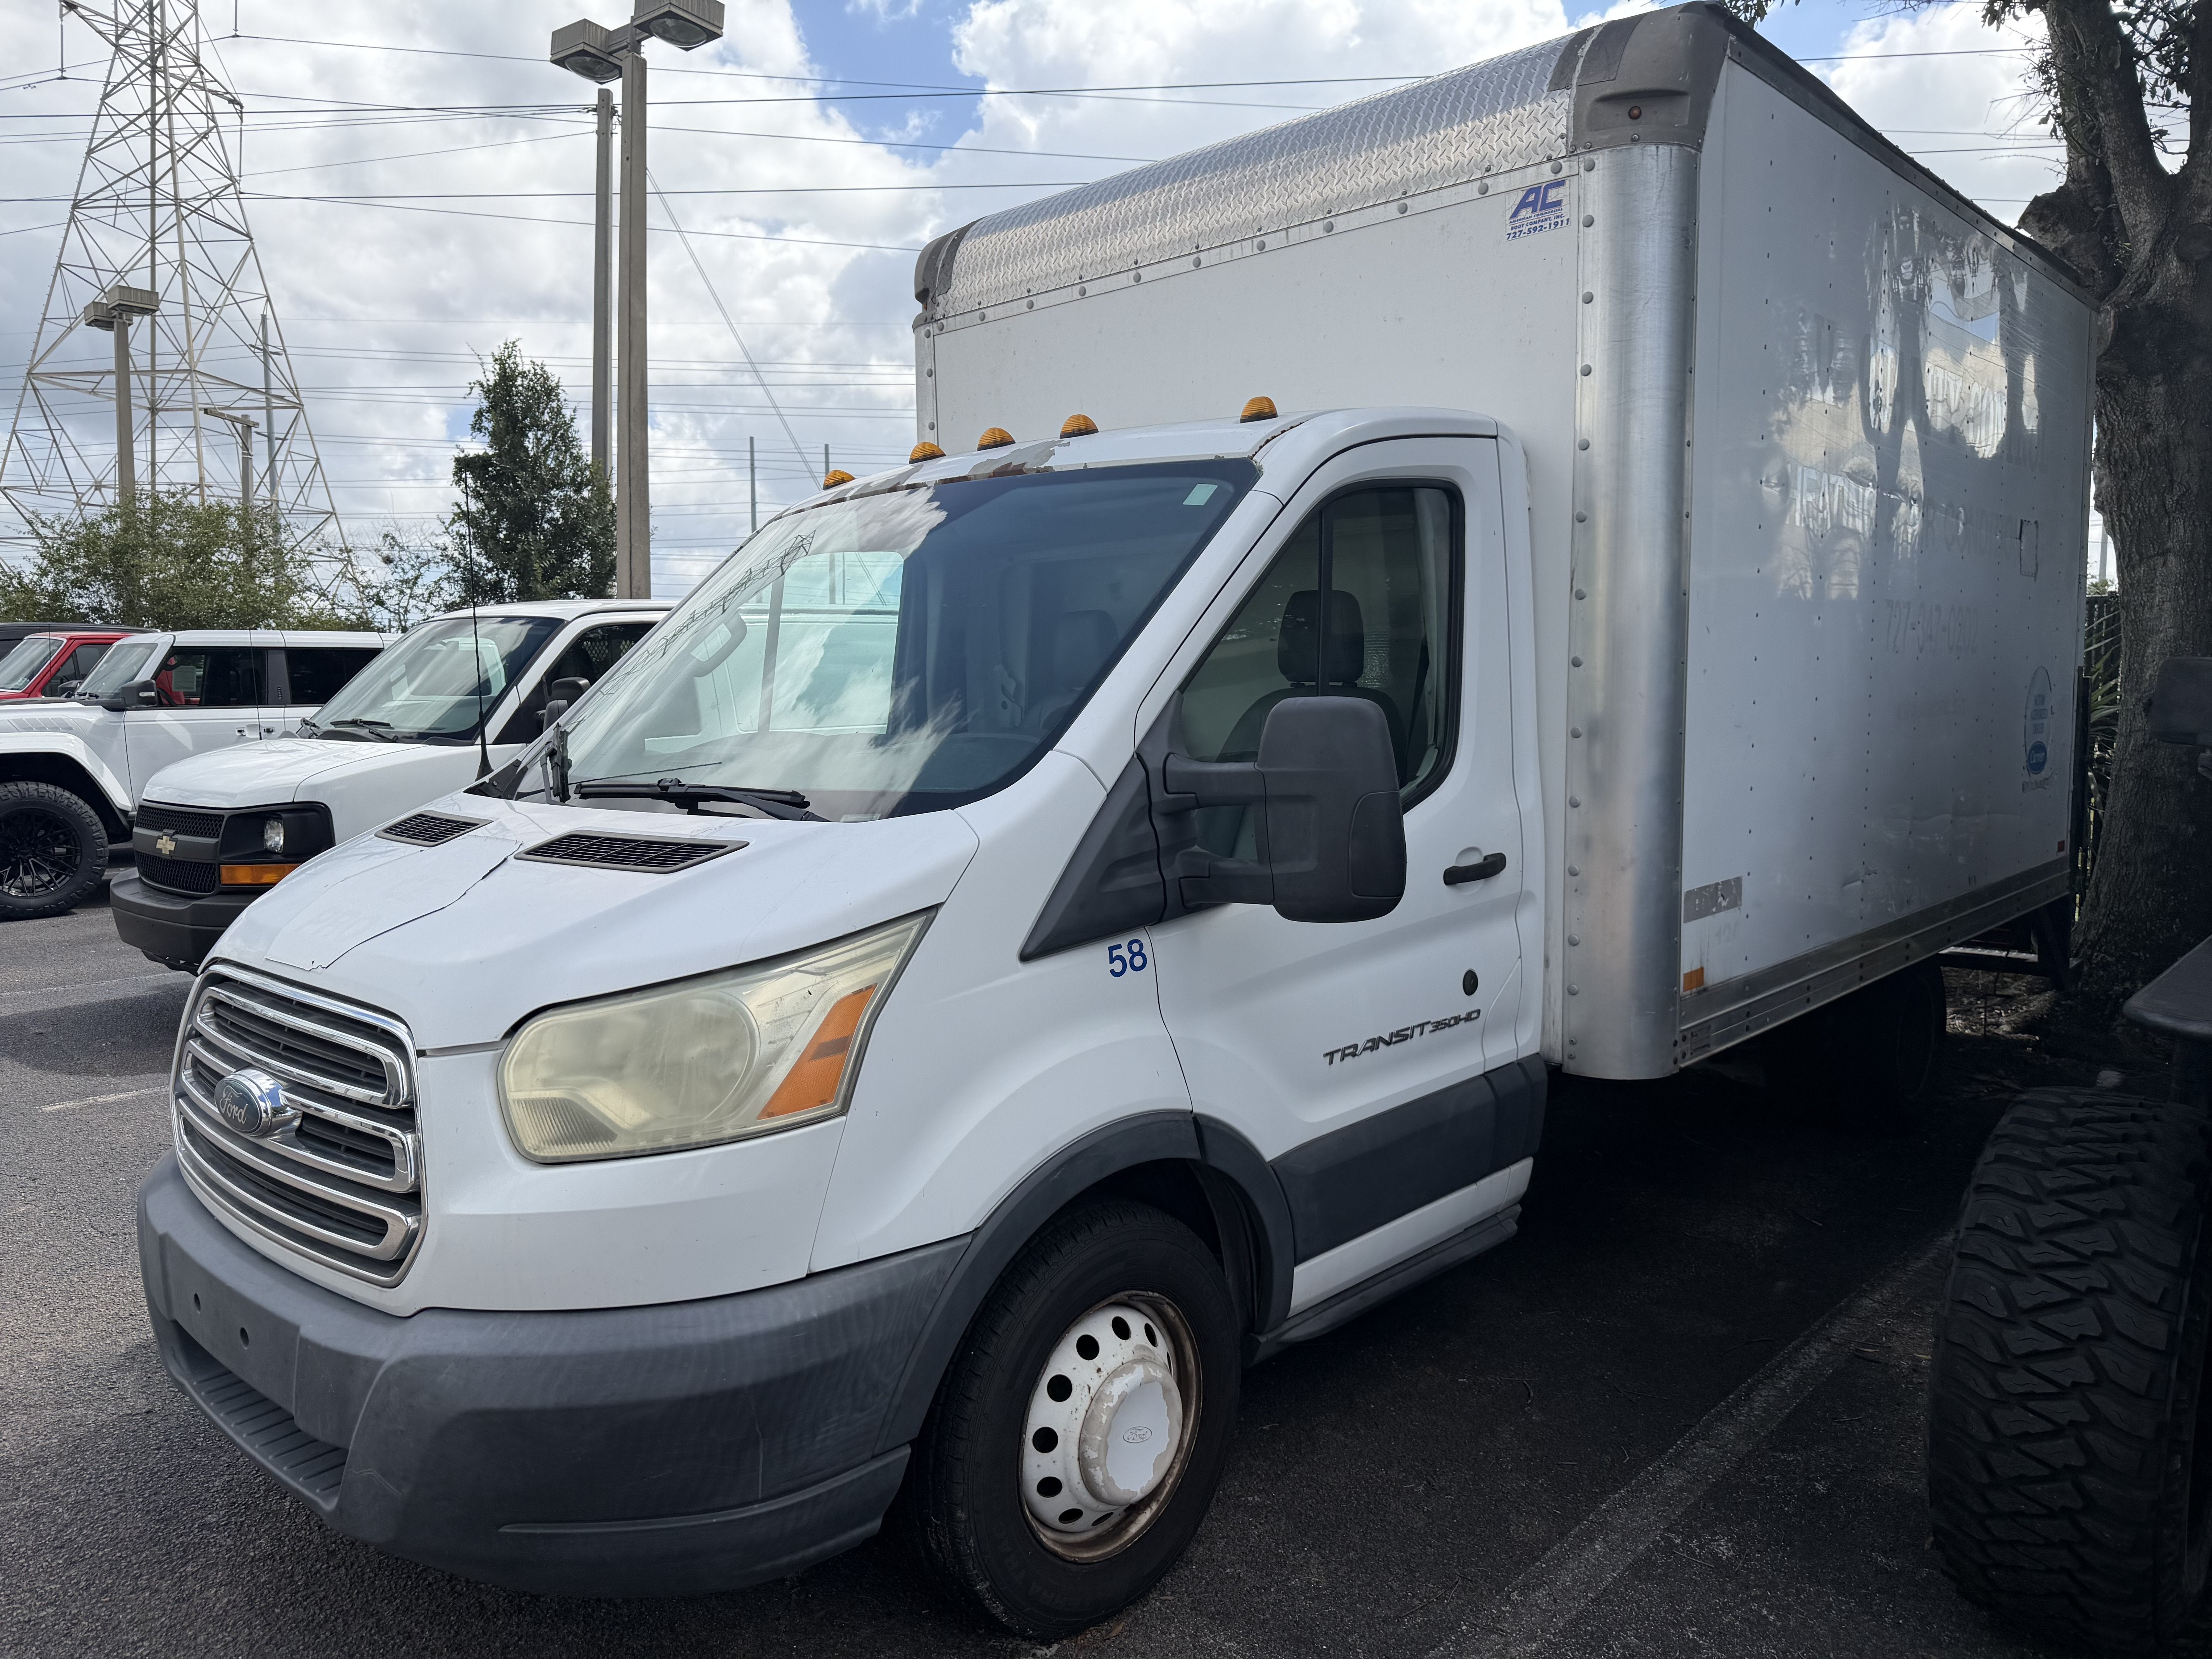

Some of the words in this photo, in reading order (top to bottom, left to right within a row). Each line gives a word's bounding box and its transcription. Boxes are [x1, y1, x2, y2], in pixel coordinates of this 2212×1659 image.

[1509, 179, 1566, 219] AC
[1509, 215, 1532, 224] AMERICAN
[1534, 208, 1563, 218] COMMERCIAL
[1506, 218, 1570, 240] 727-592-1911
[1108, 939, 1147, 977] 58
[1323, 1020, 1431, 1066] TRANSIT
[1429, 1008, 1481, 1033] 350HD
[220, 1085, 248, 1124] Ford
[1127, 1428, 1147, 1441] Ford
